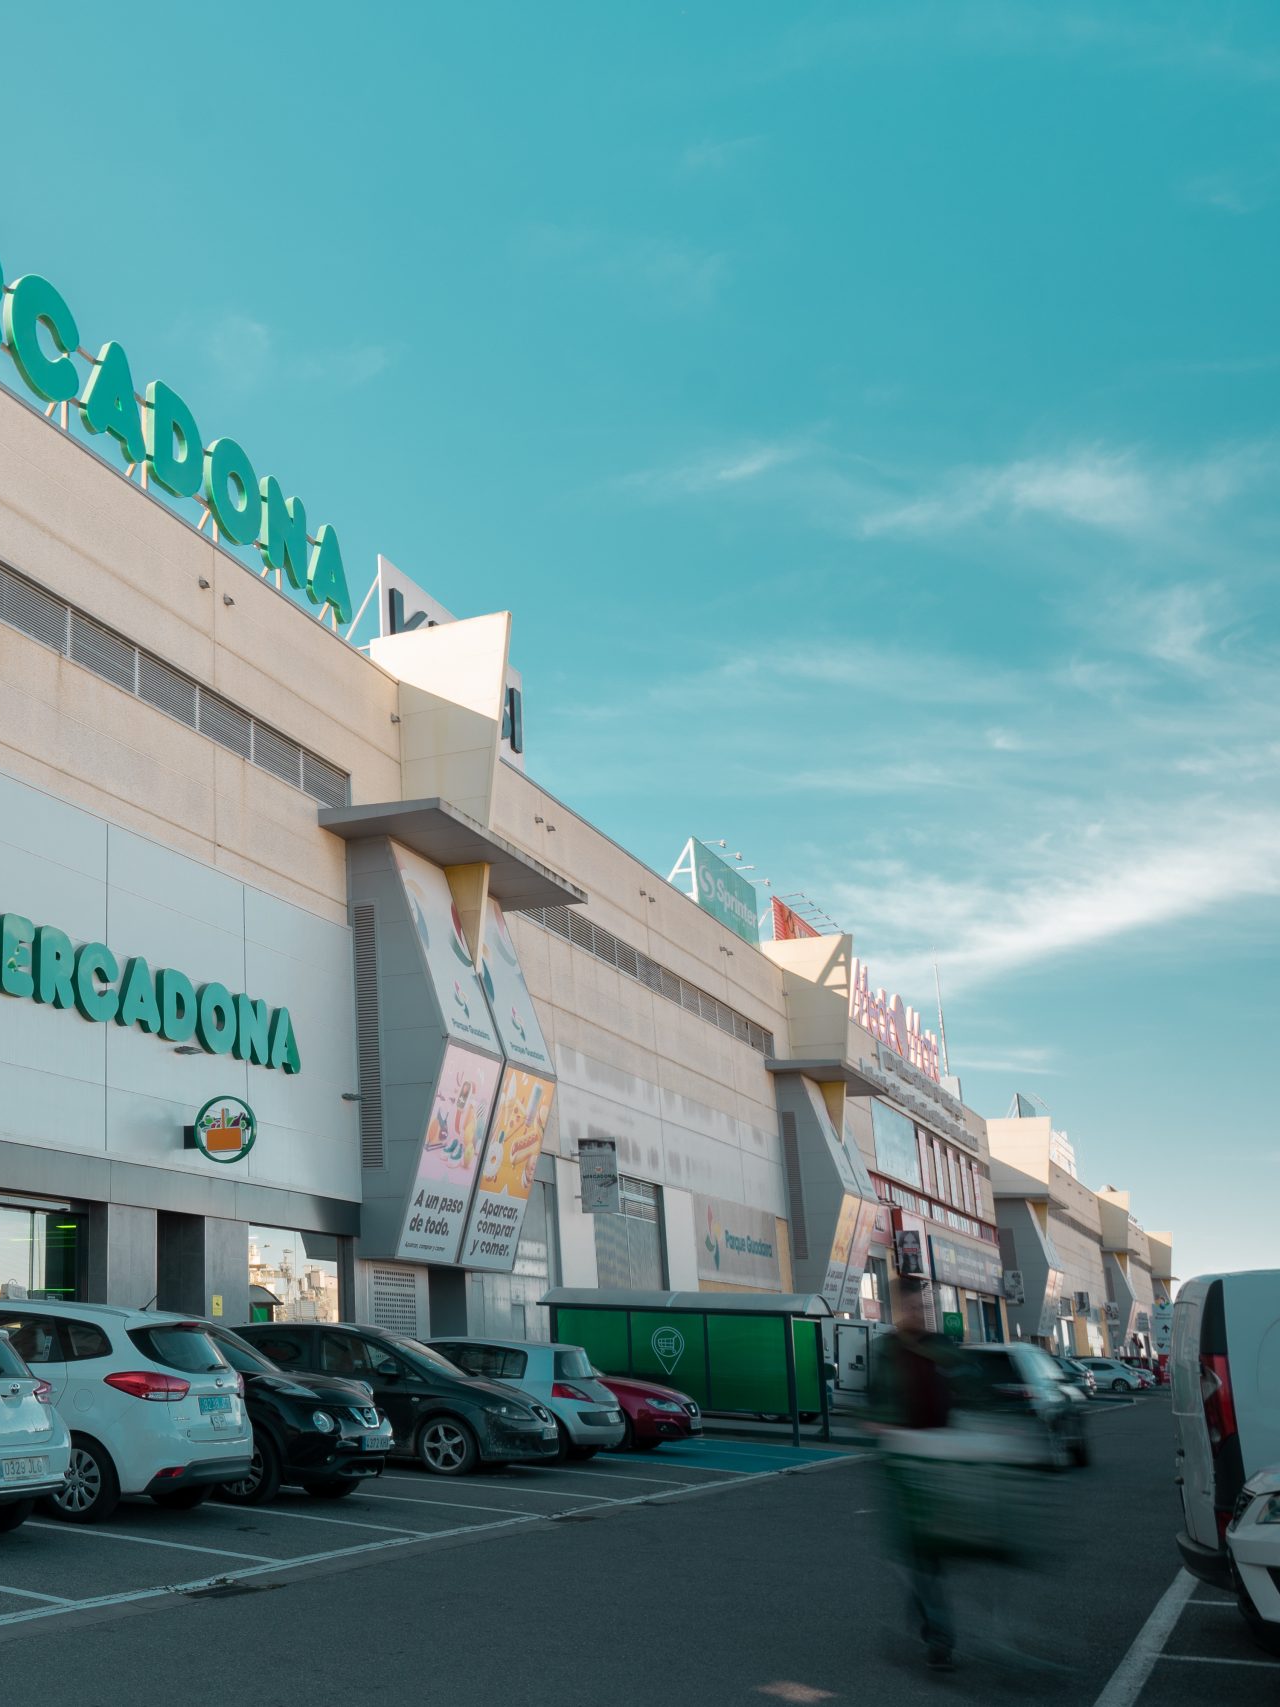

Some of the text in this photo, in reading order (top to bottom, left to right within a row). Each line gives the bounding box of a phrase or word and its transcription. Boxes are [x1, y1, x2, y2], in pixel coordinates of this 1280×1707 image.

[717, 878, 757, 928] Sprinter
[414, 1189, 464, 1214] A un paso
[480, 1198, 518, 1223] Aparcar,
[409, 1213, 450, 1237] de todo.
[477, 1219, 515, 1239] comprar
[470, 1239, 510, 1257] y comer.
[725, 1229, 746, 1256] Parque
[4, 1461, 26, 1475] 0329
